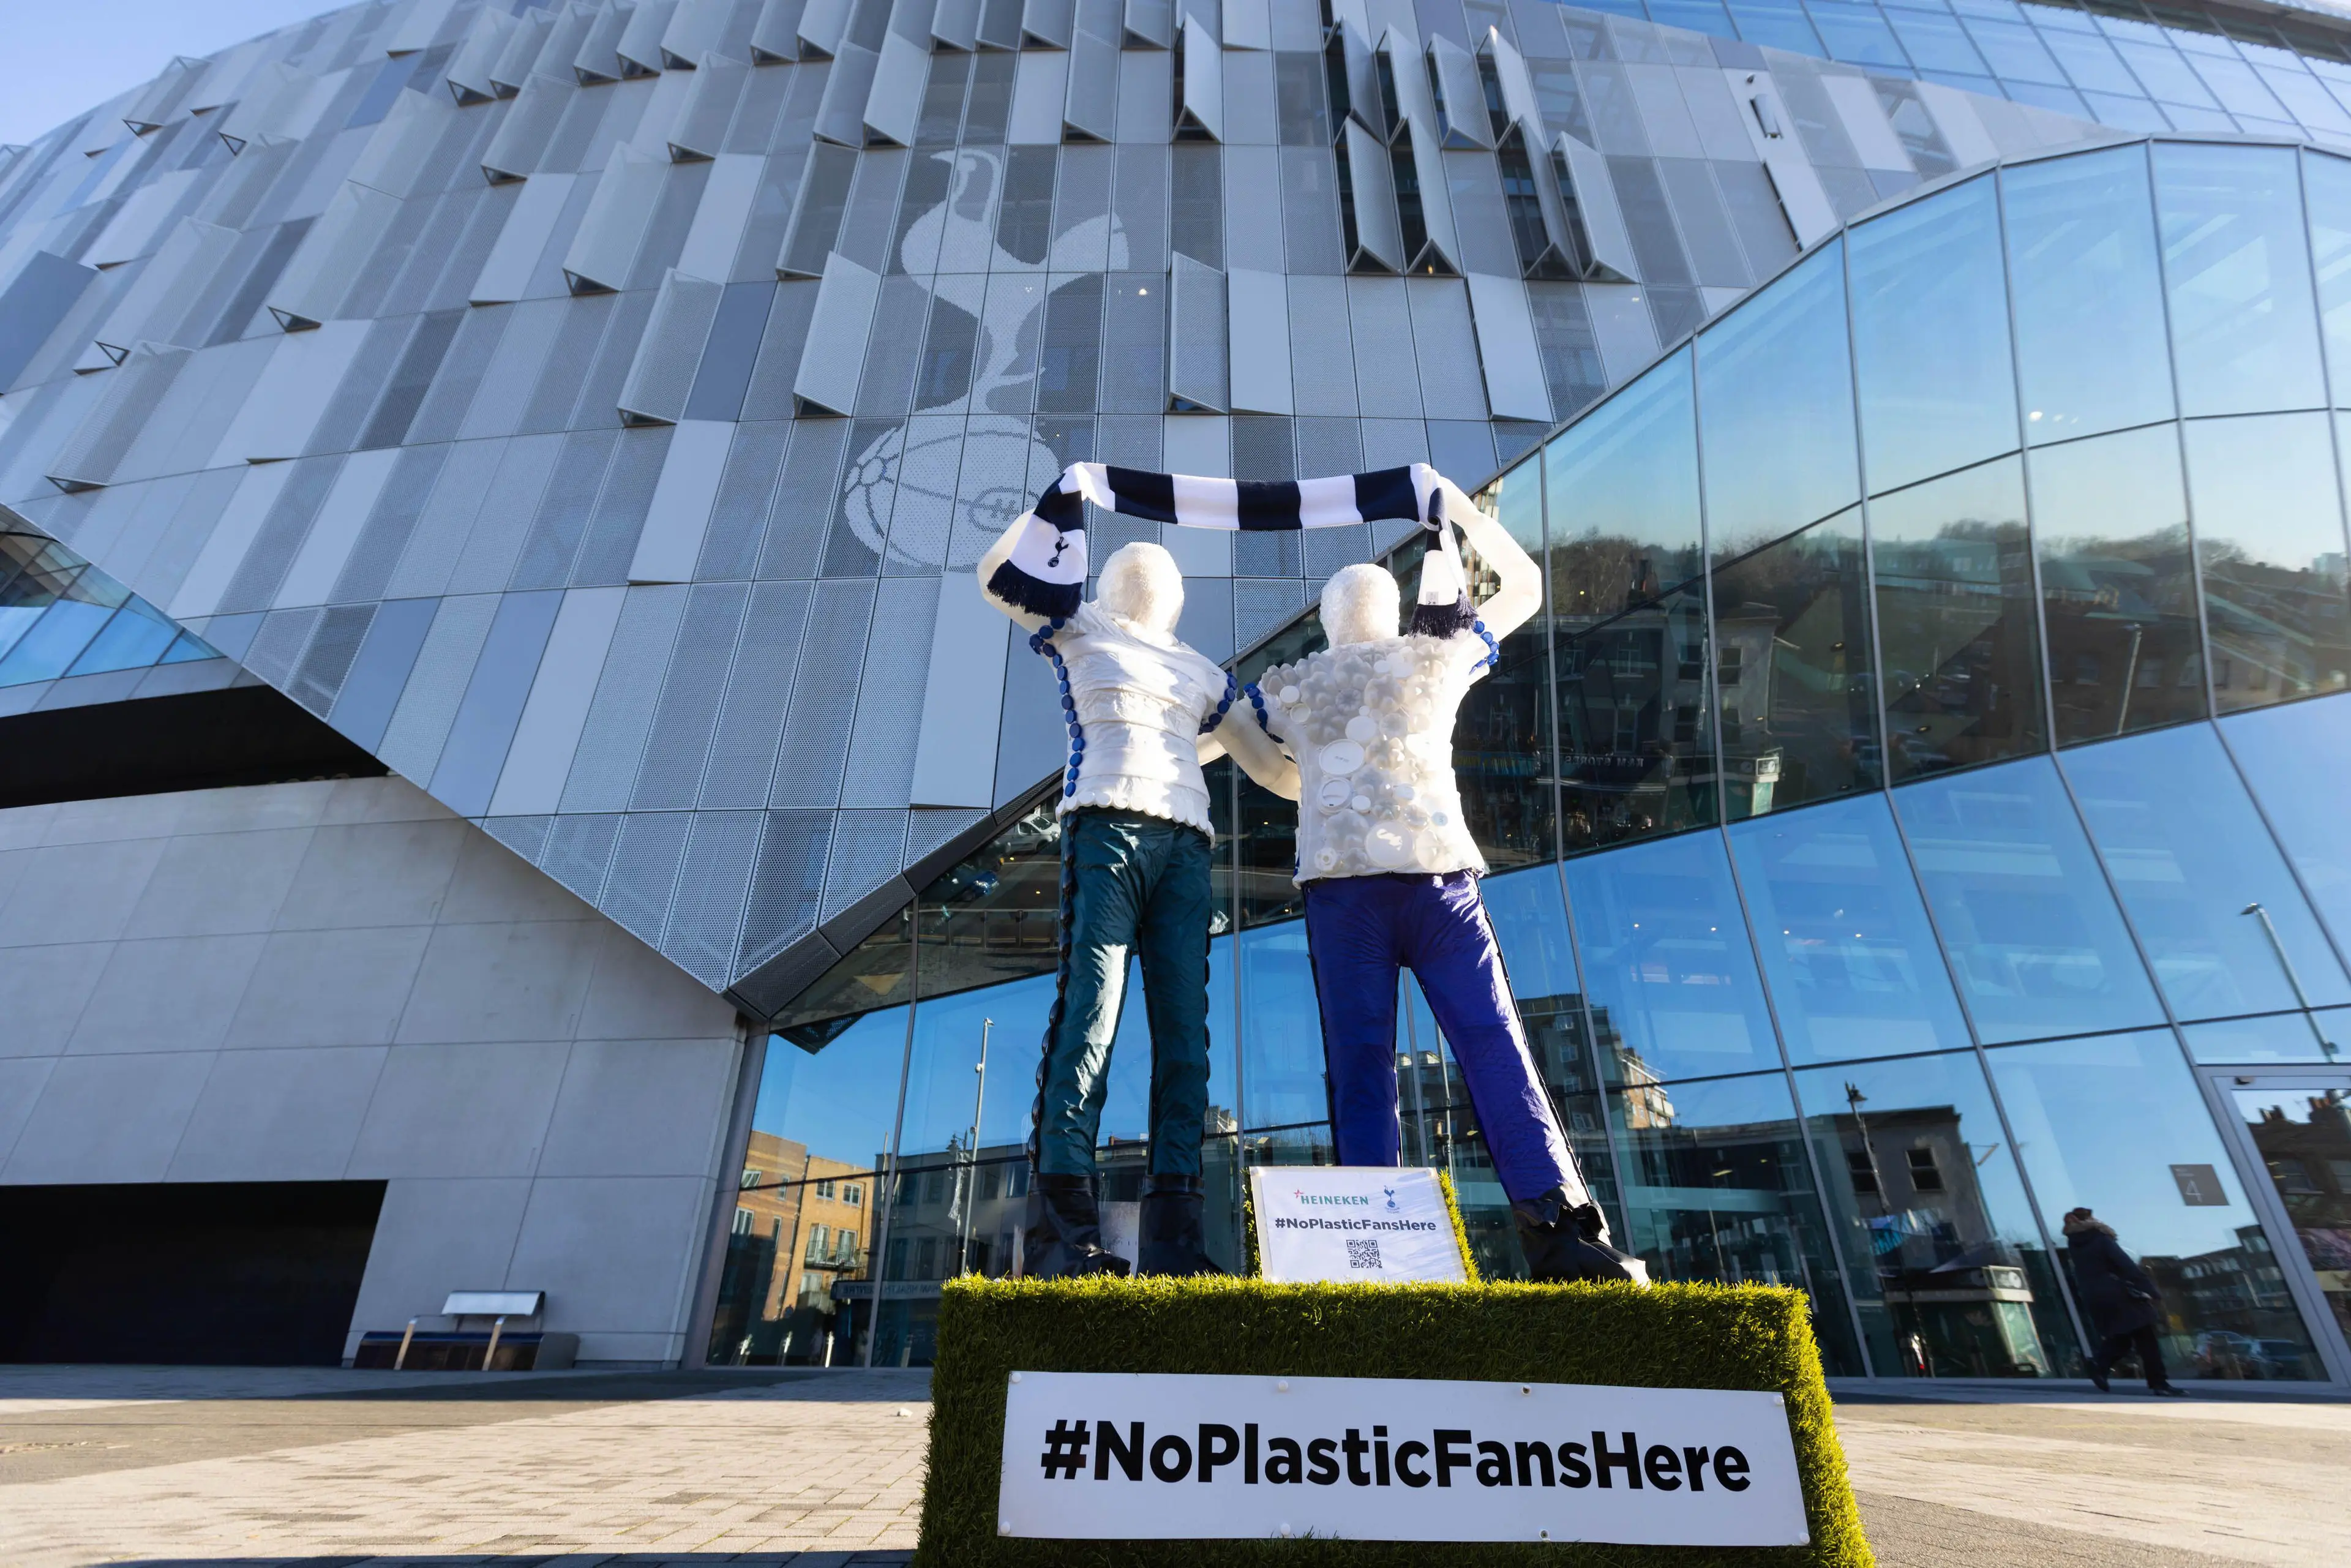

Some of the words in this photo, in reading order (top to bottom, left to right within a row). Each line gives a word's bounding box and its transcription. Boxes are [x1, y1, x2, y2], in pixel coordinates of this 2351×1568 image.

[1300, 1195, 1369, 1206] HEINEKEN
[2186, 1179, 2204, 1203] 4
[1275, 1217, 1437, 1231] #NoPlasticFansHere
[1040, 1419, 1752, 1493] #NoPlasticFansHere
